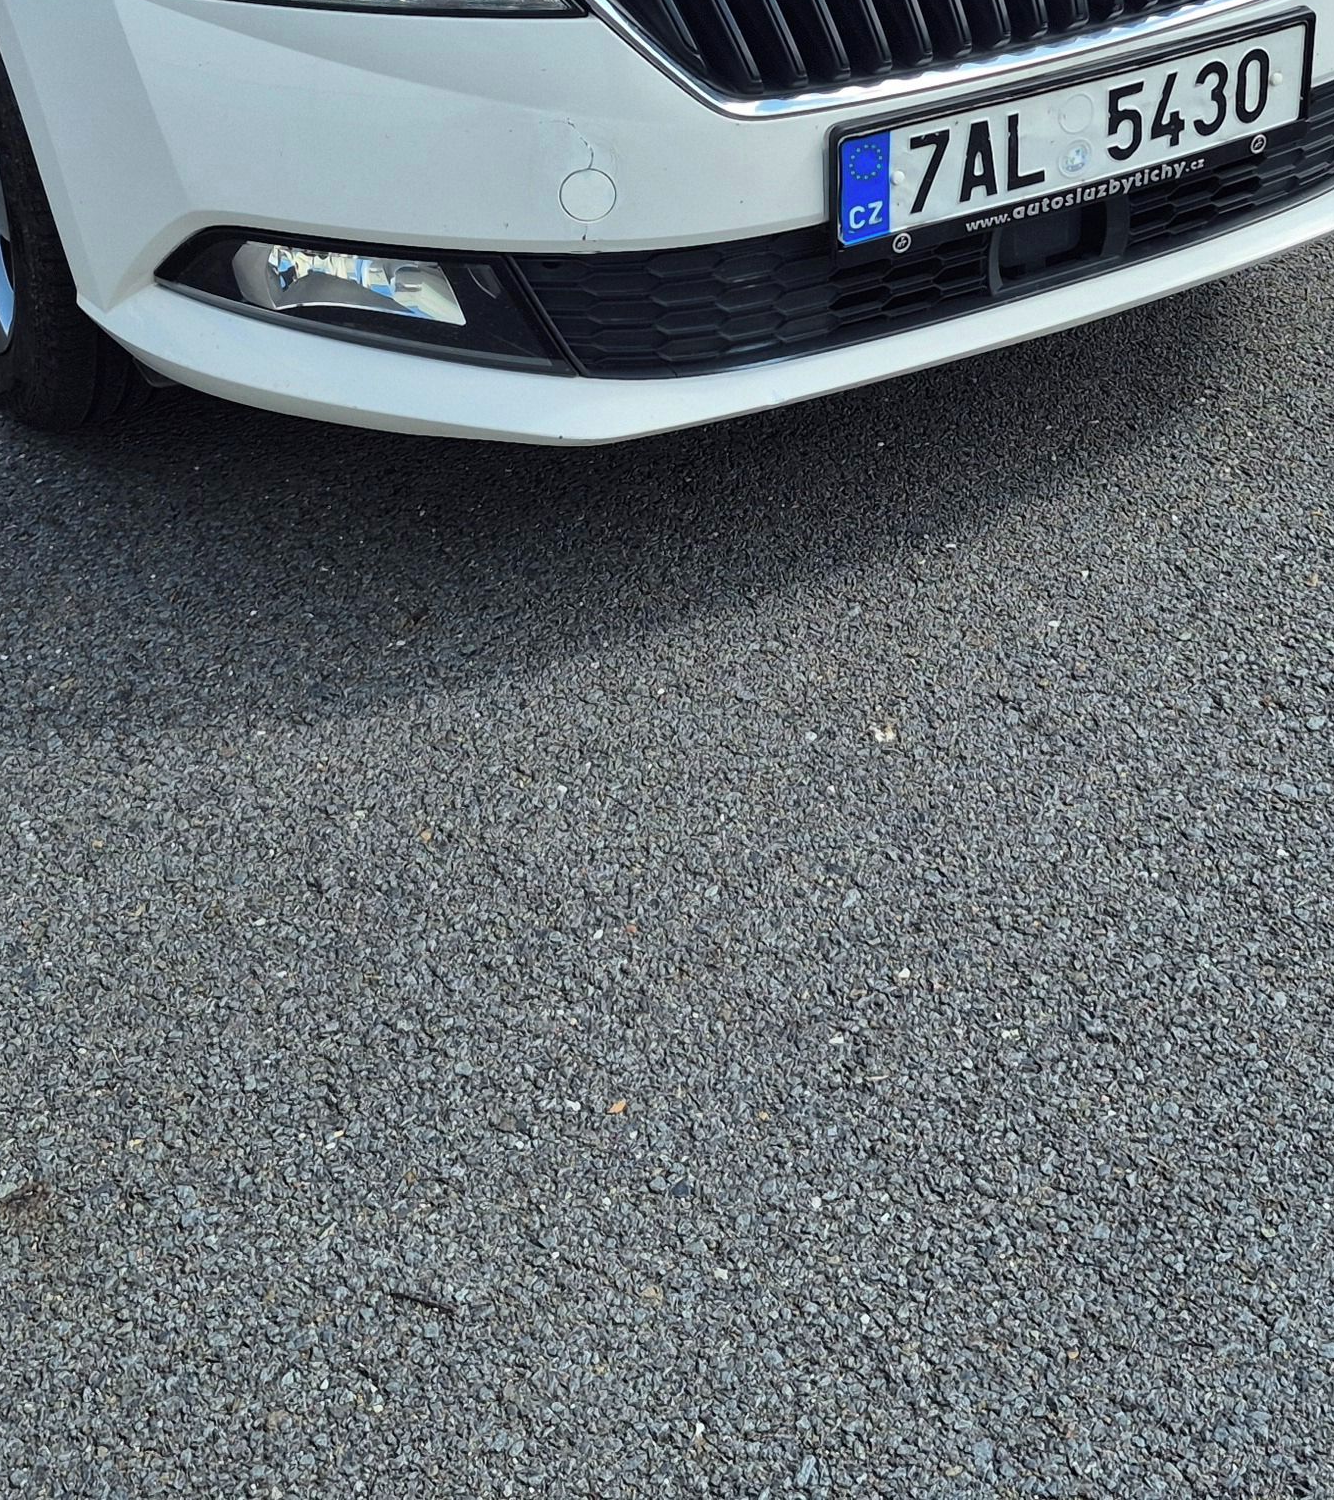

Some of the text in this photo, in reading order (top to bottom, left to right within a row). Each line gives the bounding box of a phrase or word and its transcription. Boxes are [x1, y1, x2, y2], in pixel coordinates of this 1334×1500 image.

[909, 48, 1270, 215] 7AL 5430
[848, 201, 884, 230] CZ
[966, 157, 1206, 232] www.autosluzbytichy.cz
